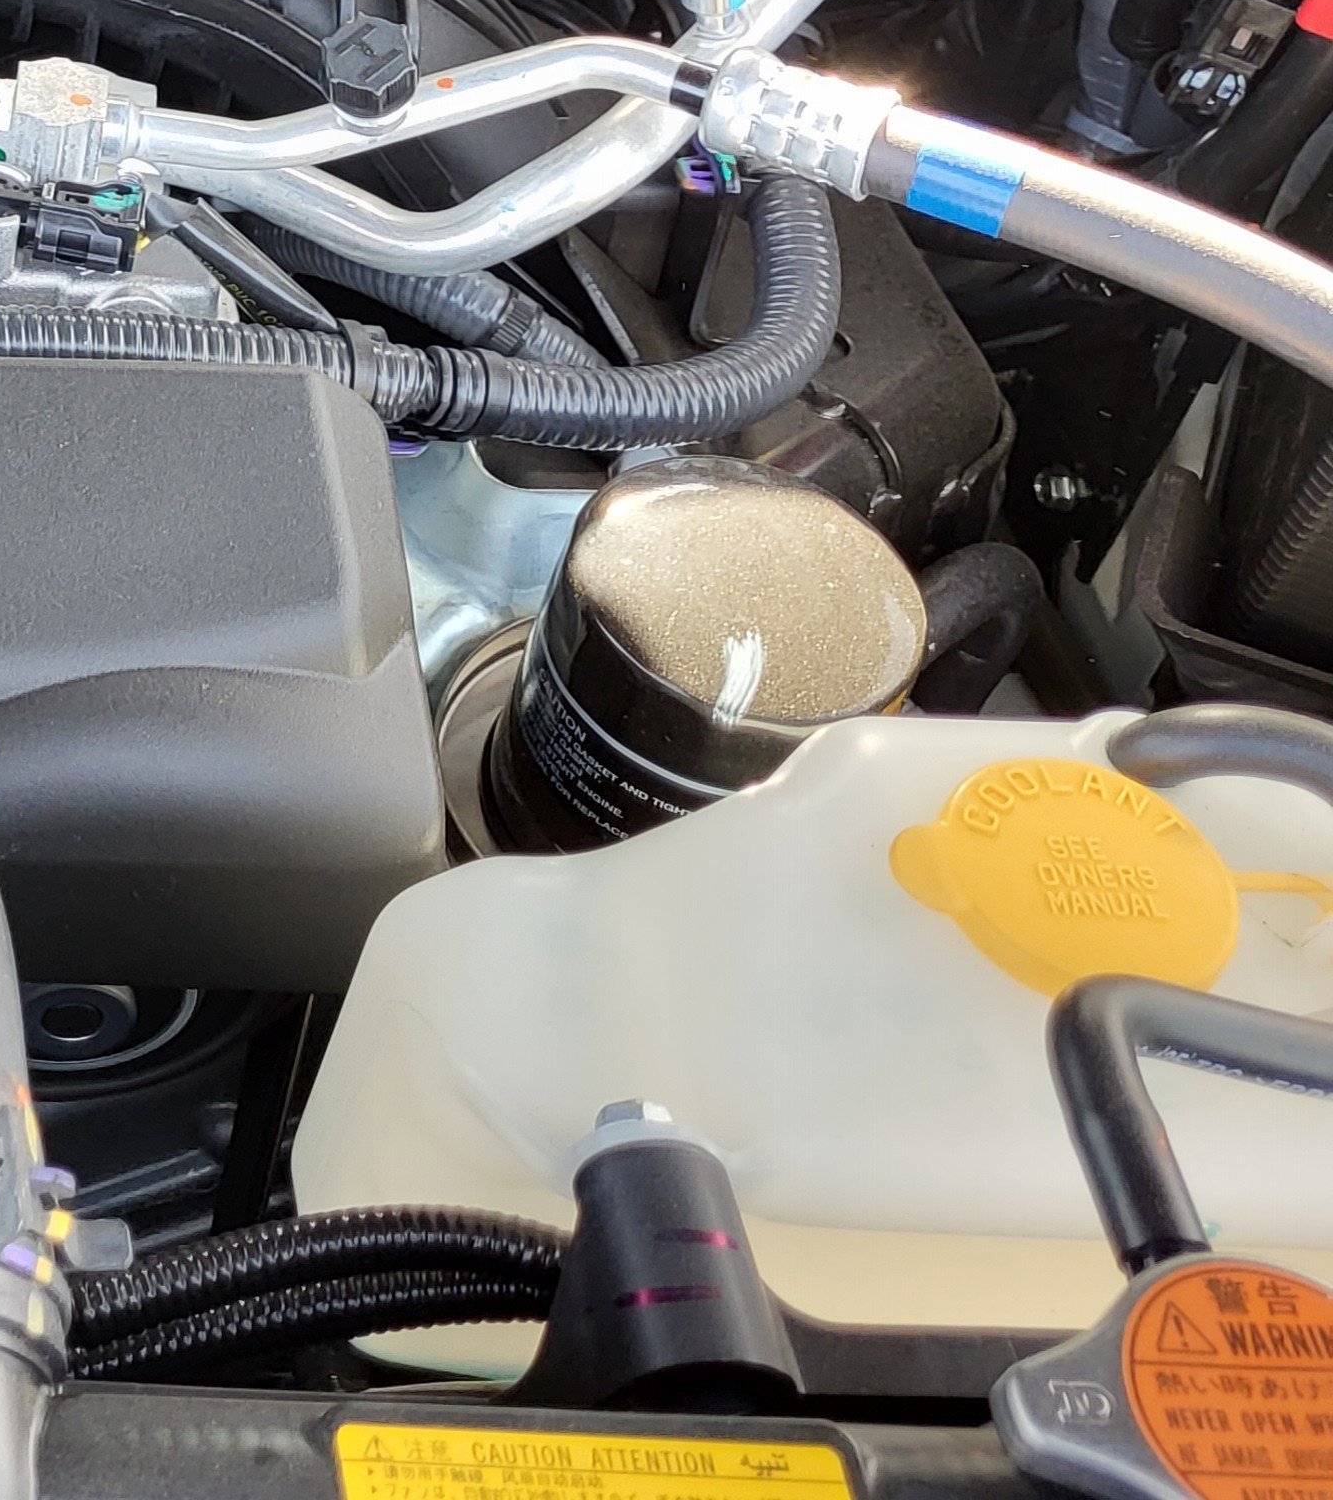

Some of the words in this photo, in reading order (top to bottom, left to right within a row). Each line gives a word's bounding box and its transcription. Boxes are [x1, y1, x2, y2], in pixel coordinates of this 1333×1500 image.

[539, 667, 587, 742] CAUTION
[573, 742, 619, 782] GASKET
[619, 781, 649, 801] AND
[963, 764, 1187, 834] COOLANT
[1045, 835, 1108, 861] SEE
[1037, 862, 1160, 890] OWNERS
[1045, 890, 1171, 918] MANUAL
[1165, 1407, 1232, 1432] NEVER
[1241, 1410, 1297, 1435] OPEN
[471, 1441, 572, 1468] CAUTION
[591, 1447, 716, 1475] ATTENTION
